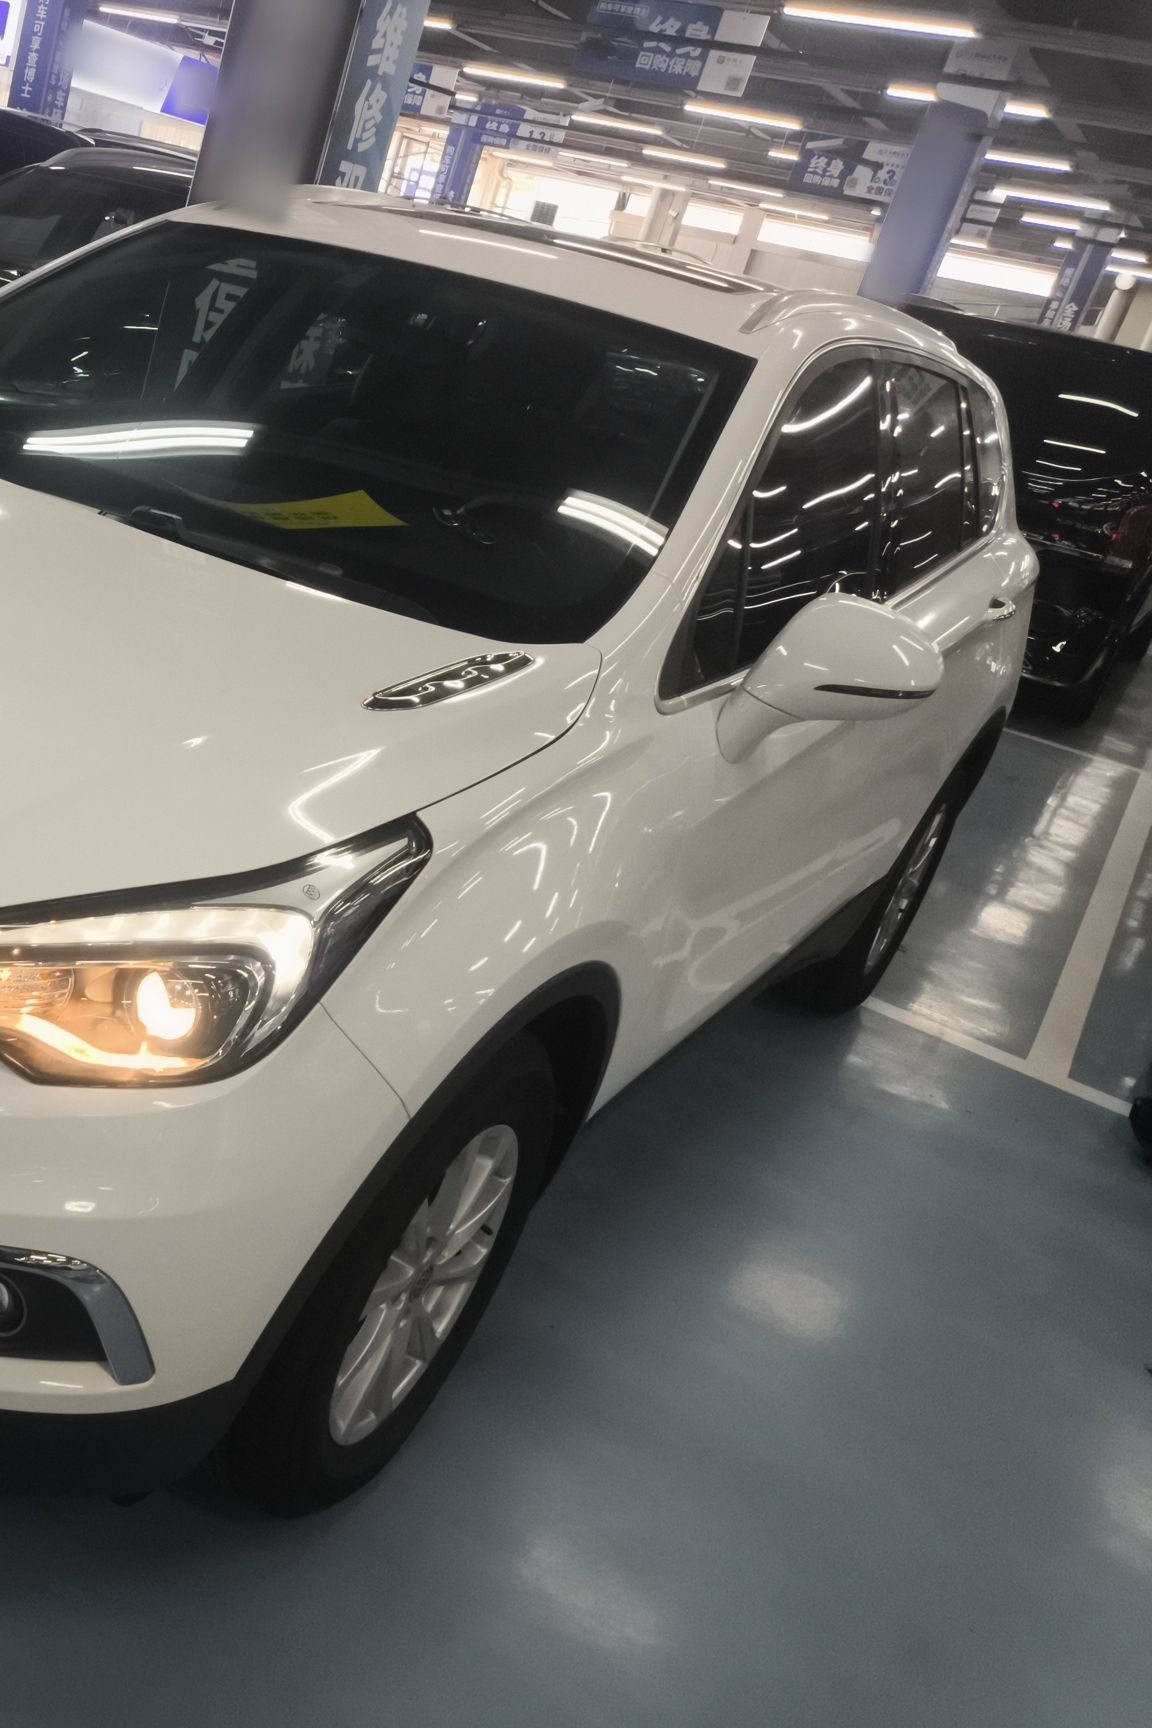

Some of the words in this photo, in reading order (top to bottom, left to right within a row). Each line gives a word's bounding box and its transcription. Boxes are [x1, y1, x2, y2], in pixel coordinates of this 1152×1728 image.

[20, 0, 49, 98] 车可享查博士
[635, 51, 703, 78] 回购保障
[807, 155, 844, 178] 终身
